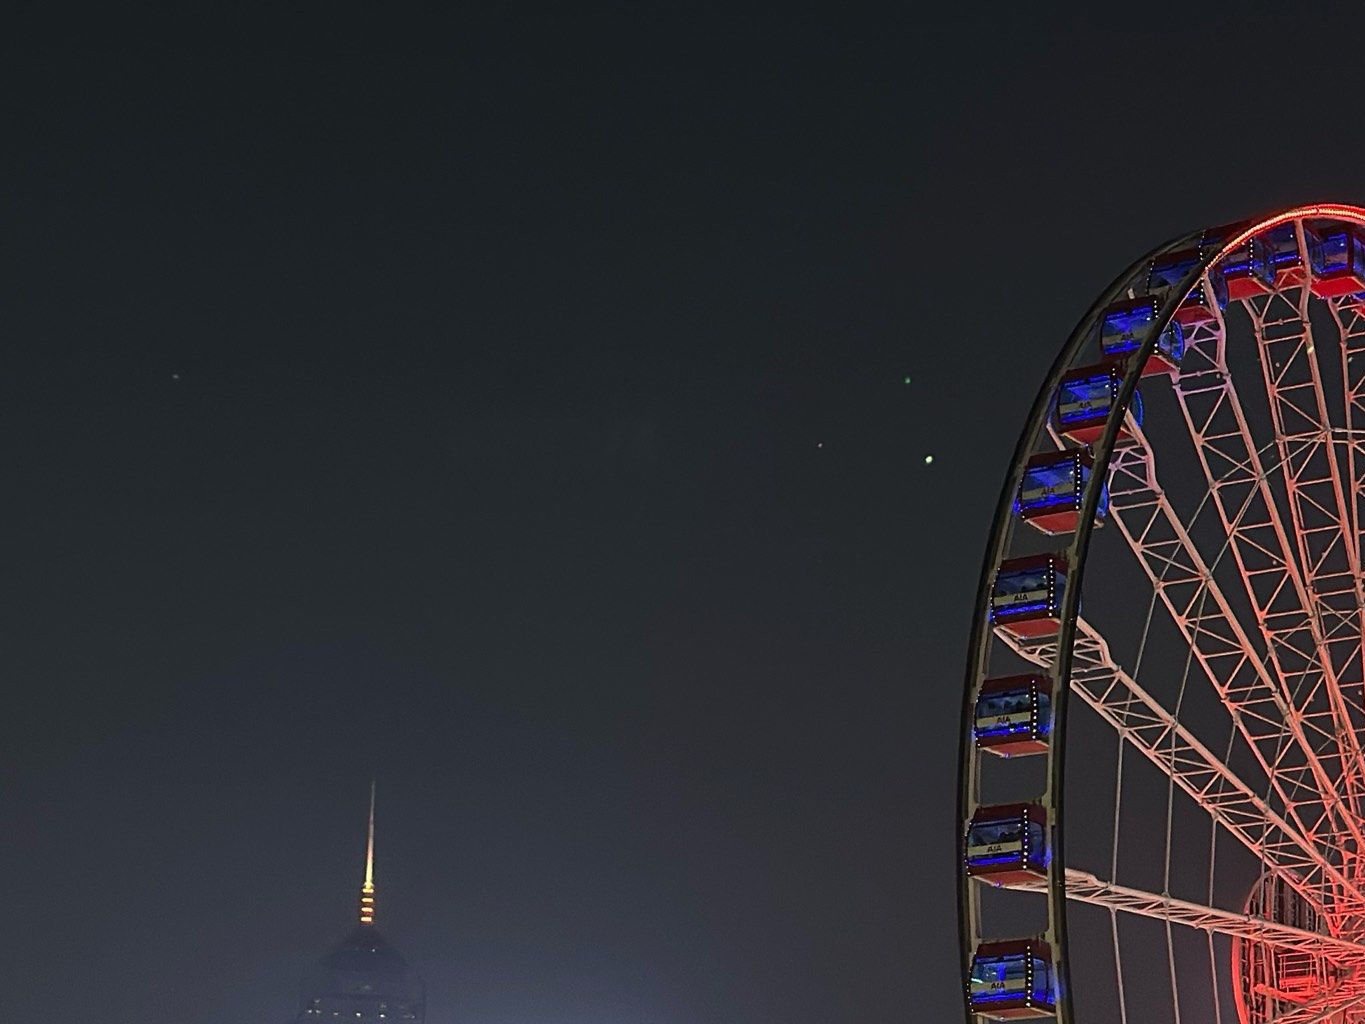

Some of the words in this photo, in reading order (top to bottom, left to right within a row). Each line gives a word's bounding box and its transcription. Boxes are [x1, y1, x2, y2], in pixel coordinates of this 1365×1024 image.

[1013, 594, 1028, 602] AIA
[996, 716, 1010, 724] AIA
[986, 845, 1002, 853] AIA
